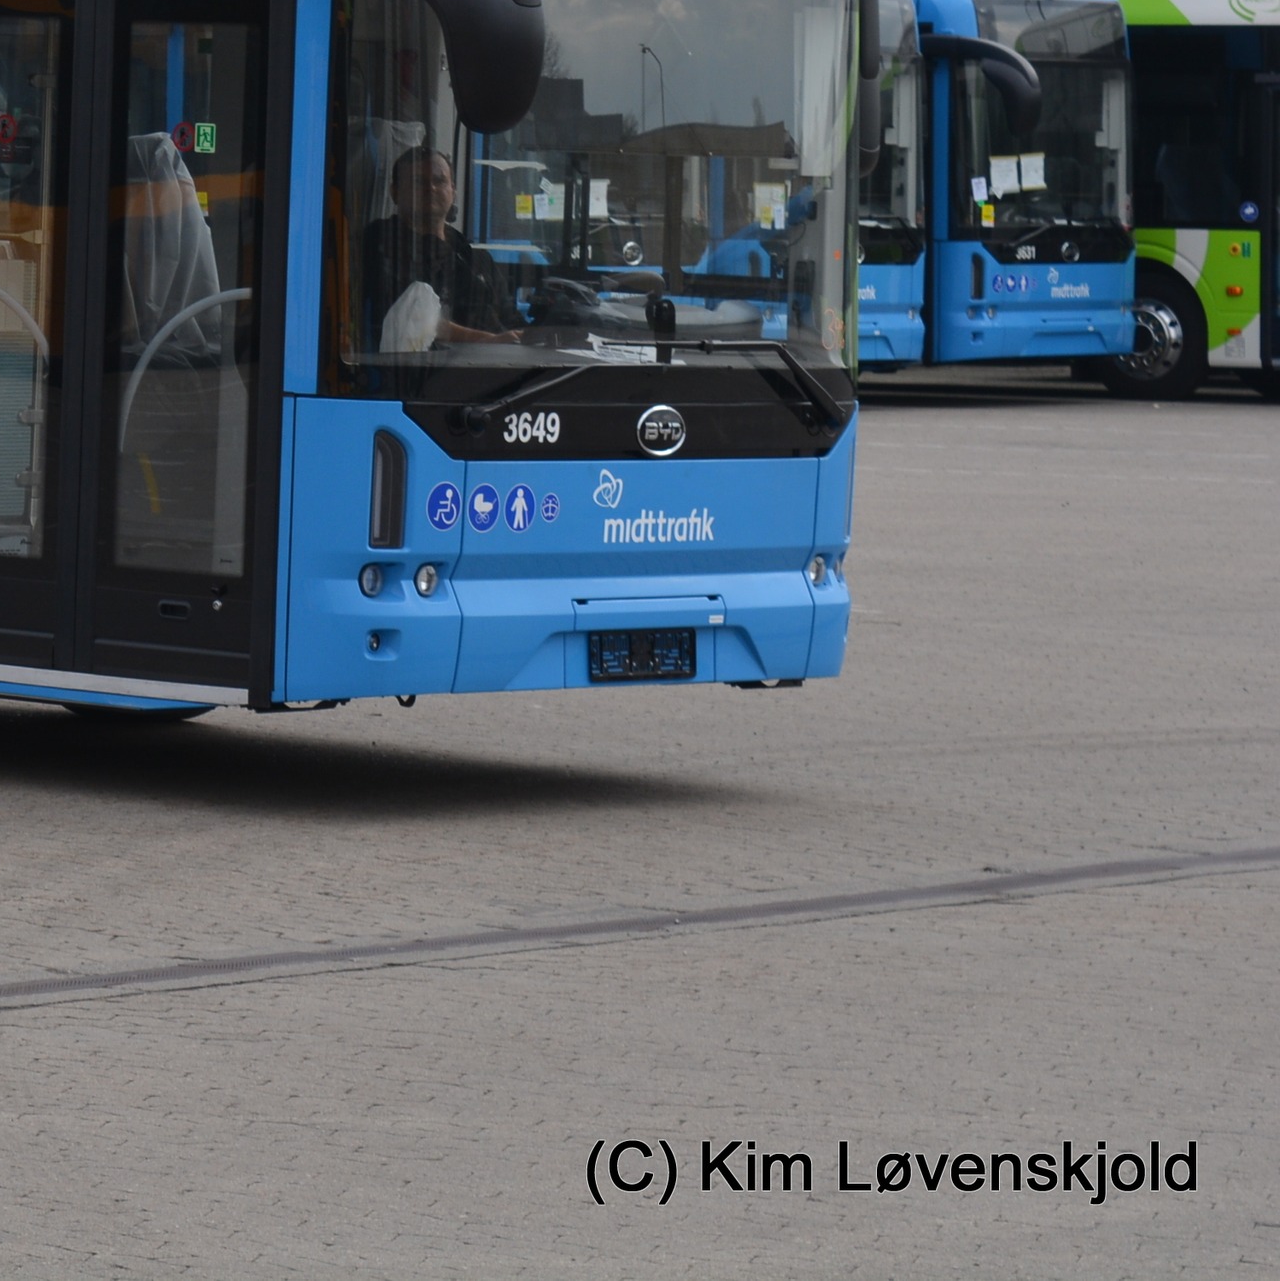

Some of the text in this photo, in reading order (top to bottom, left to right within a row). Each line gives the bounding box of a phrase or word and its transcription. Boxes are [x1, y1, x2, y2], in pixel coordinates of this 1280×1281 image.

[503, 412, 560, 444] 3649
[644, 421, 682, 441] BYD
[603, 507, 715, 544] midttrafik
